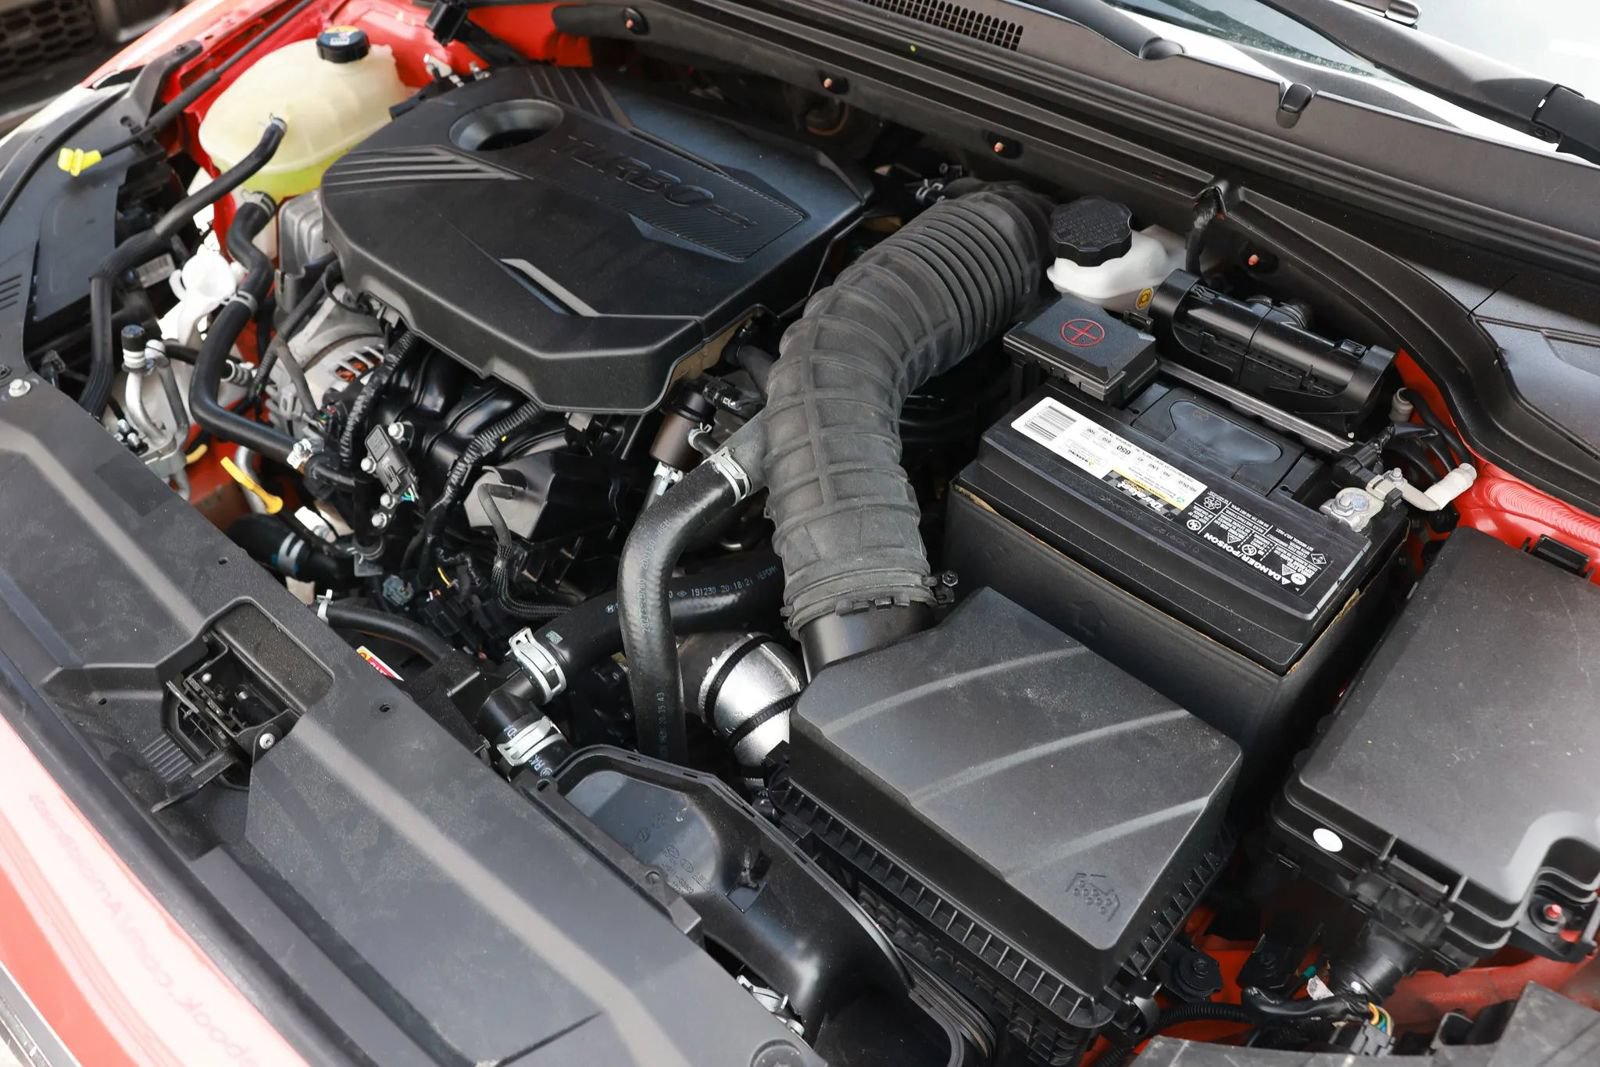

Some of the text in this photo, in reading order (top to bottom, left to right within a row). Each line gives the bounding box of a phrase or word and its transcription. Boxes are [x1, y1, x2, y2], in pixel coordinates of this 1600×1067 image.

[1114, 444, 1132, 455] 650
[1115, 480, 1165, 511] Duralast
[1203, 531, 1281, 581] DANGER/POISON
